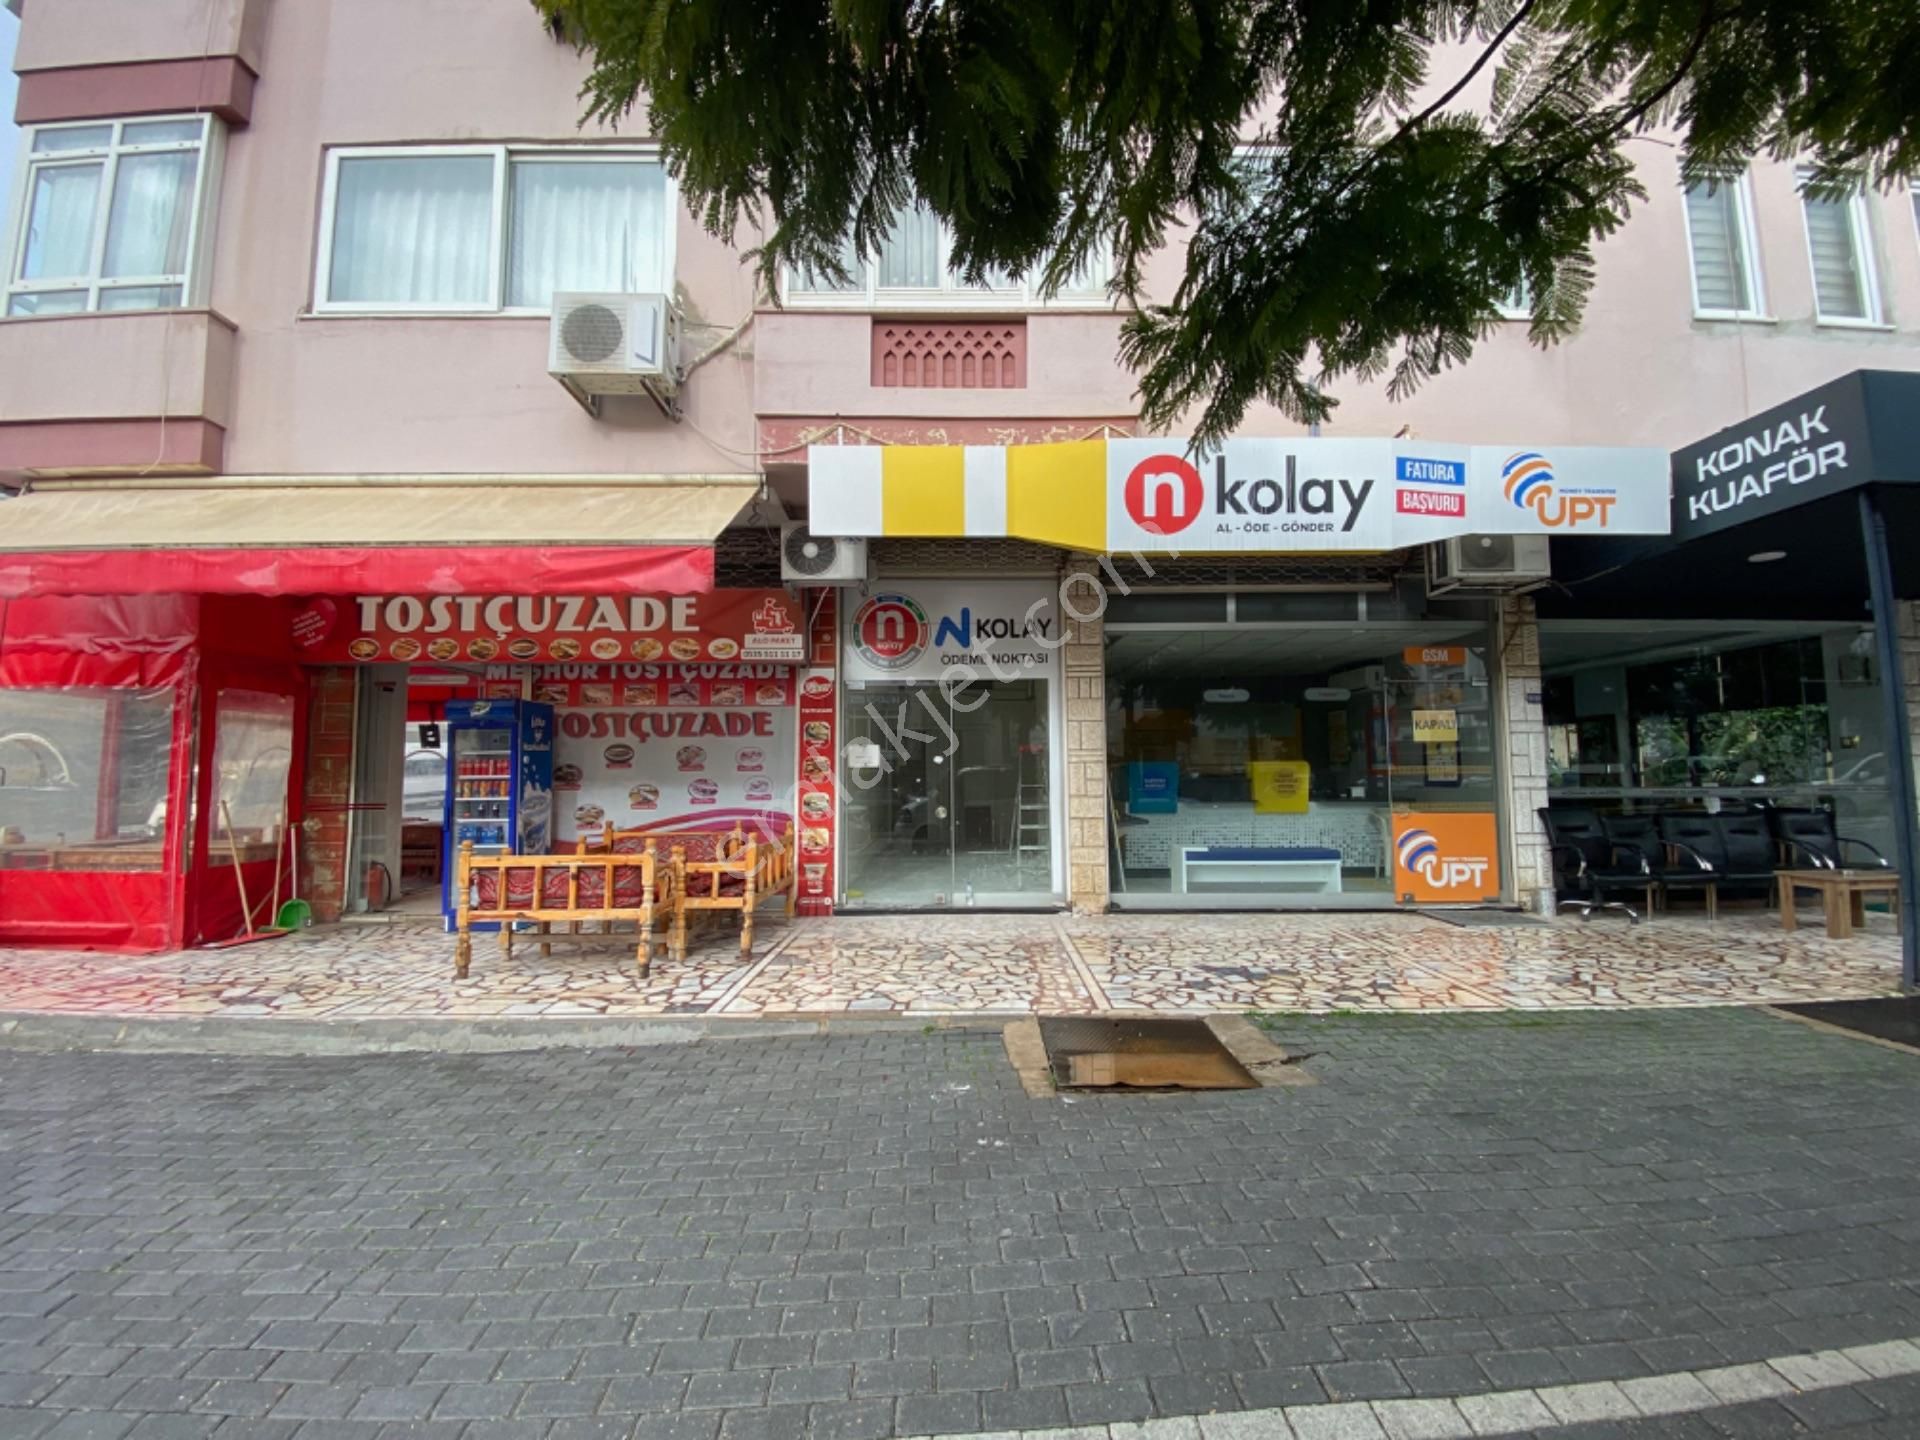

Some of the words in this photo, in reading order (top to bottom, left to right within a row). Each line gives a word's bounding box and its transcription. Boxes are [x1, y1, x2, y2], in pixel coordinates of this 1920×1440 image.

[1697, 405, 1829, 482] KONAK
[1405, 461, 1455, 482] FATURA
[1689, 441, 1848, 521] KUAFÖR
[1216, 455, 1374, 532] kolay
[1403, 491, 1459, 513] BAŞVURU
[1537, 496, 1616, 527] UPT
[1216, 523, 1232, 533] AL
[1243, 521, 1270, 533] ÖDE
[1281, 521, 1334, 533] GÖNDER
[356, 595, 699, 640] TOSTÇUZADE
[976, 618, 1052, 639] KOLAY
[1422, 648, 1448, 662] GSM
[1426, 863, 1488, 888] UPT
